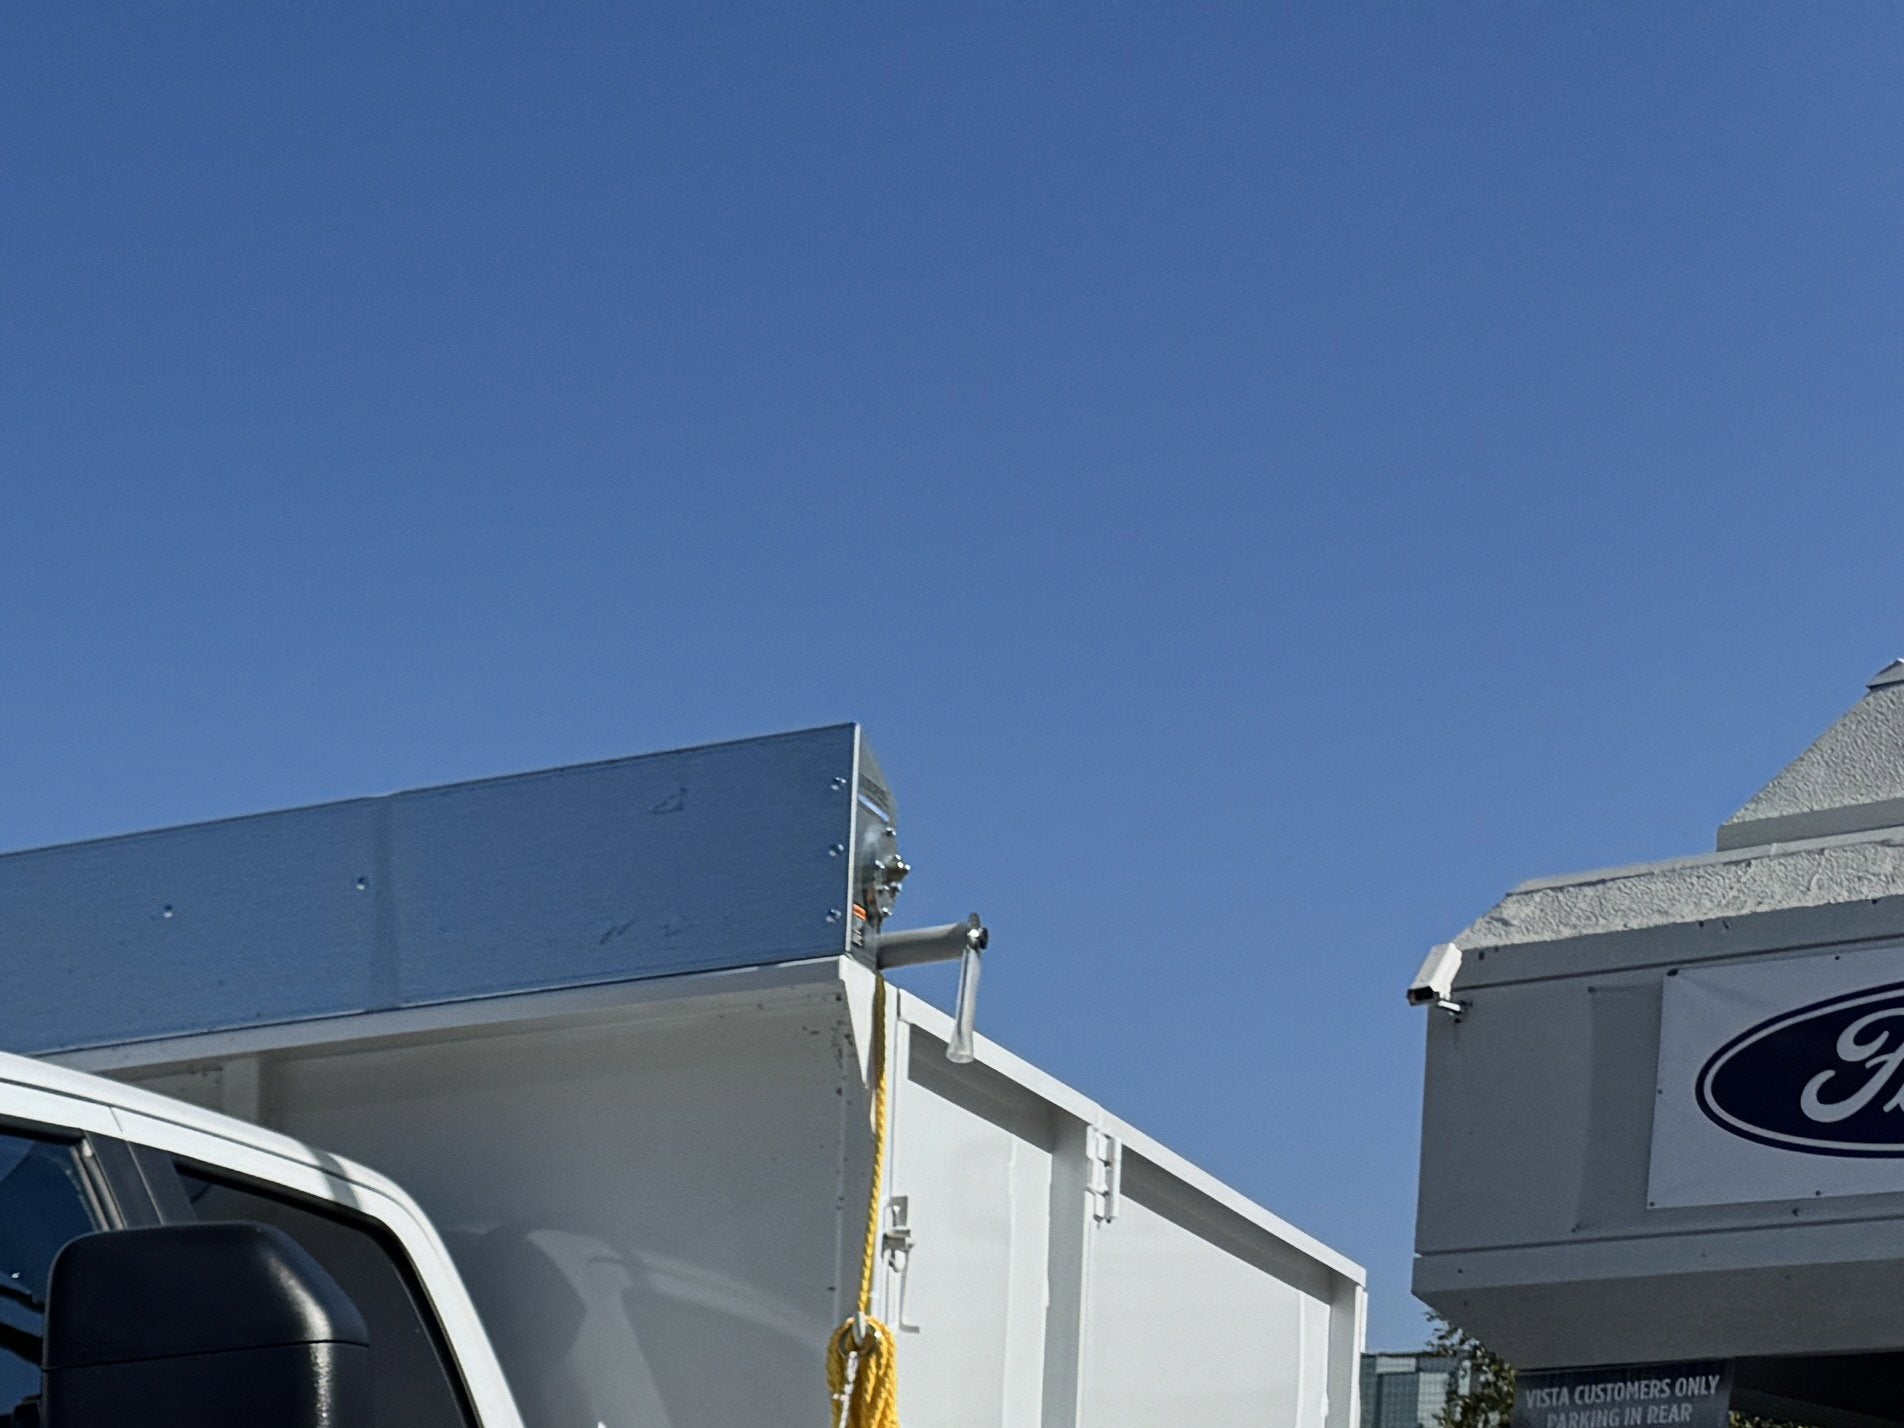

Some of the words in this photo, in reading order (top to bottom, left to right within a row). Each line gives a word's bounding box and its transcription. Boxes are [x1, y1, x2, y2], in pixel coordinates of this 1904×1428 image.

[1525, 1385, 1570, 1409] VISTA
[1574, 1379, 1671, 1405] CUSTOMERS
[1675, 1375, 1720, 1398] ONLY
[1624, 1406, 1641, 1426] IN
[1647, 1403, 1692, 1424] REAR
